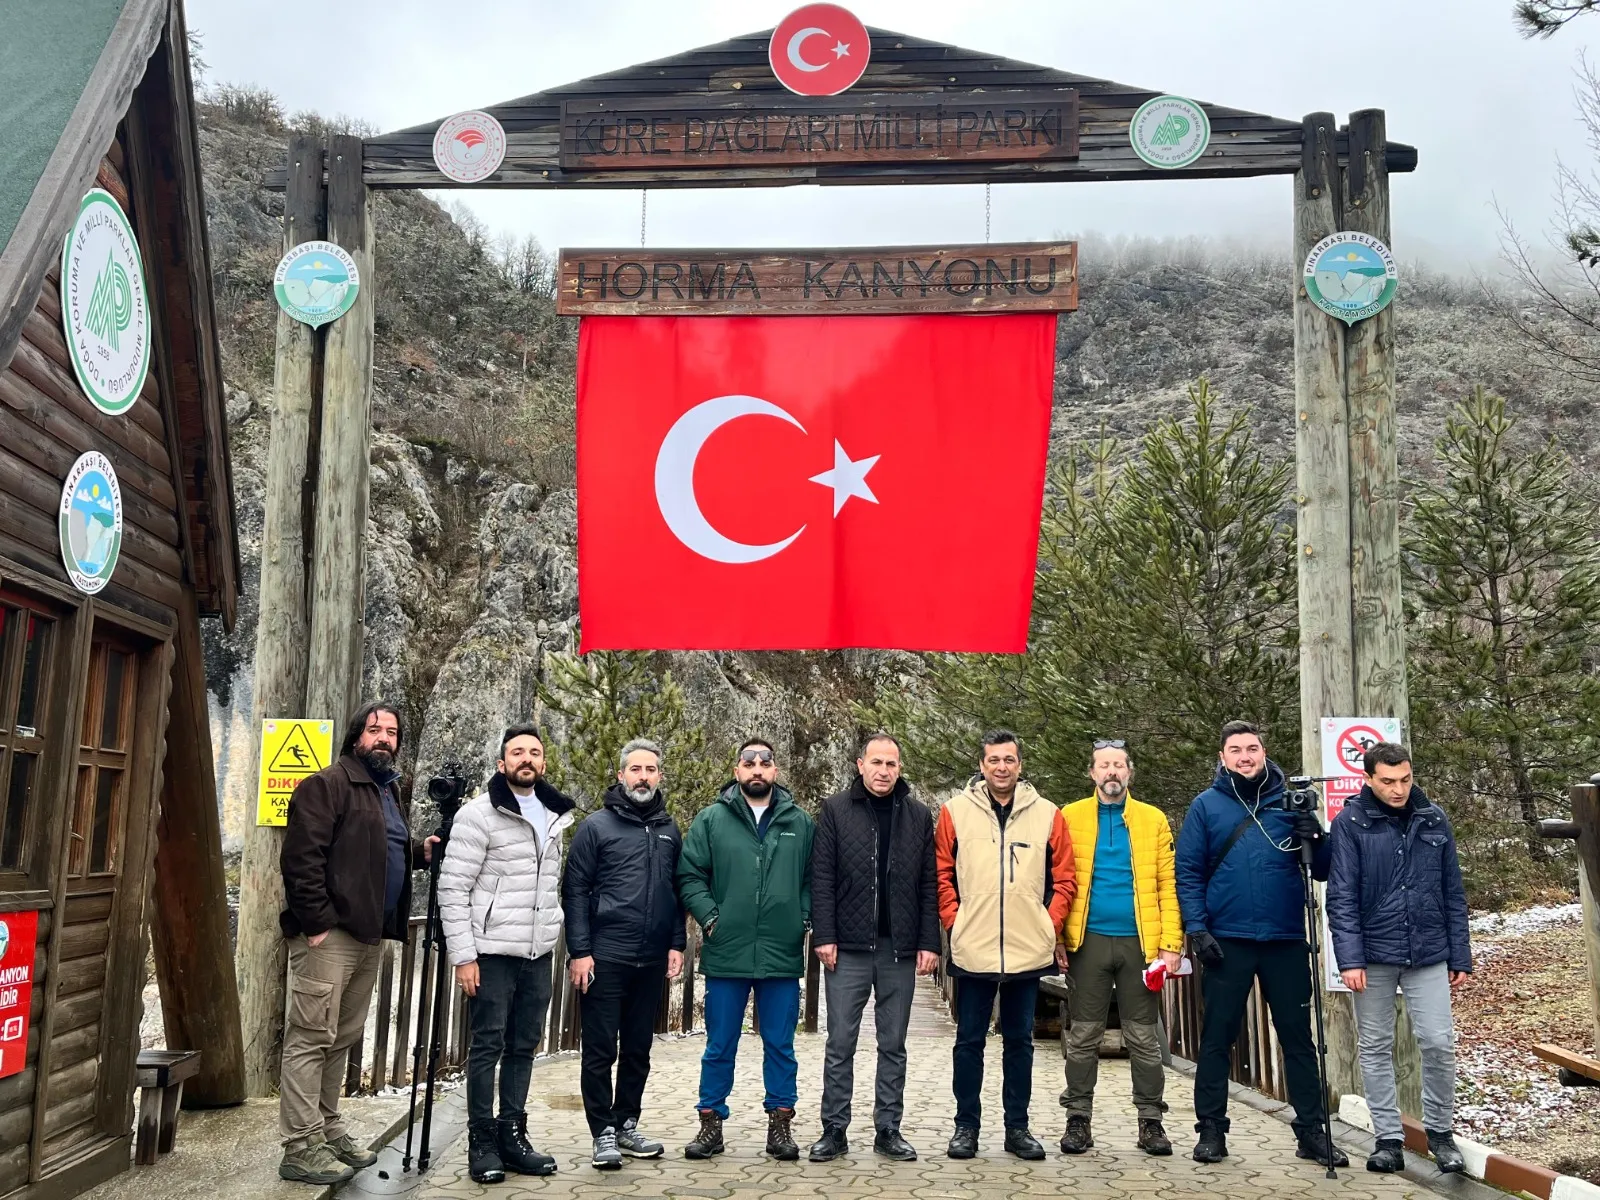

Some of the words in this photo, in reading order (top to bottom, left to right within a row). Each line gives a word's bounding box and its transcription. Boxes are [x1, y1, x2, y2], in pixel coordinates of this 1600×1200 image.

[575, 110, 671, 156] KÜRE
[853, 104, 943, 151] MİLLİ
[957, 108, 1062, 149] PARKI
[76, 232, 86, 251] VE
[85, 210, 103, 233] MİLLİ
[104, 215, 135, 269] PARKLAR
[72, 257, 83, 335] KORUMA
[577, 262, 761, 300] HORMA
[803, 257, 1056, 299] KANYONU
[132, 273, 143, 329] GENEL
[1319, 299, 1380, 318] KASTAMONU
[80, 339, 99, 381] DOĞA
